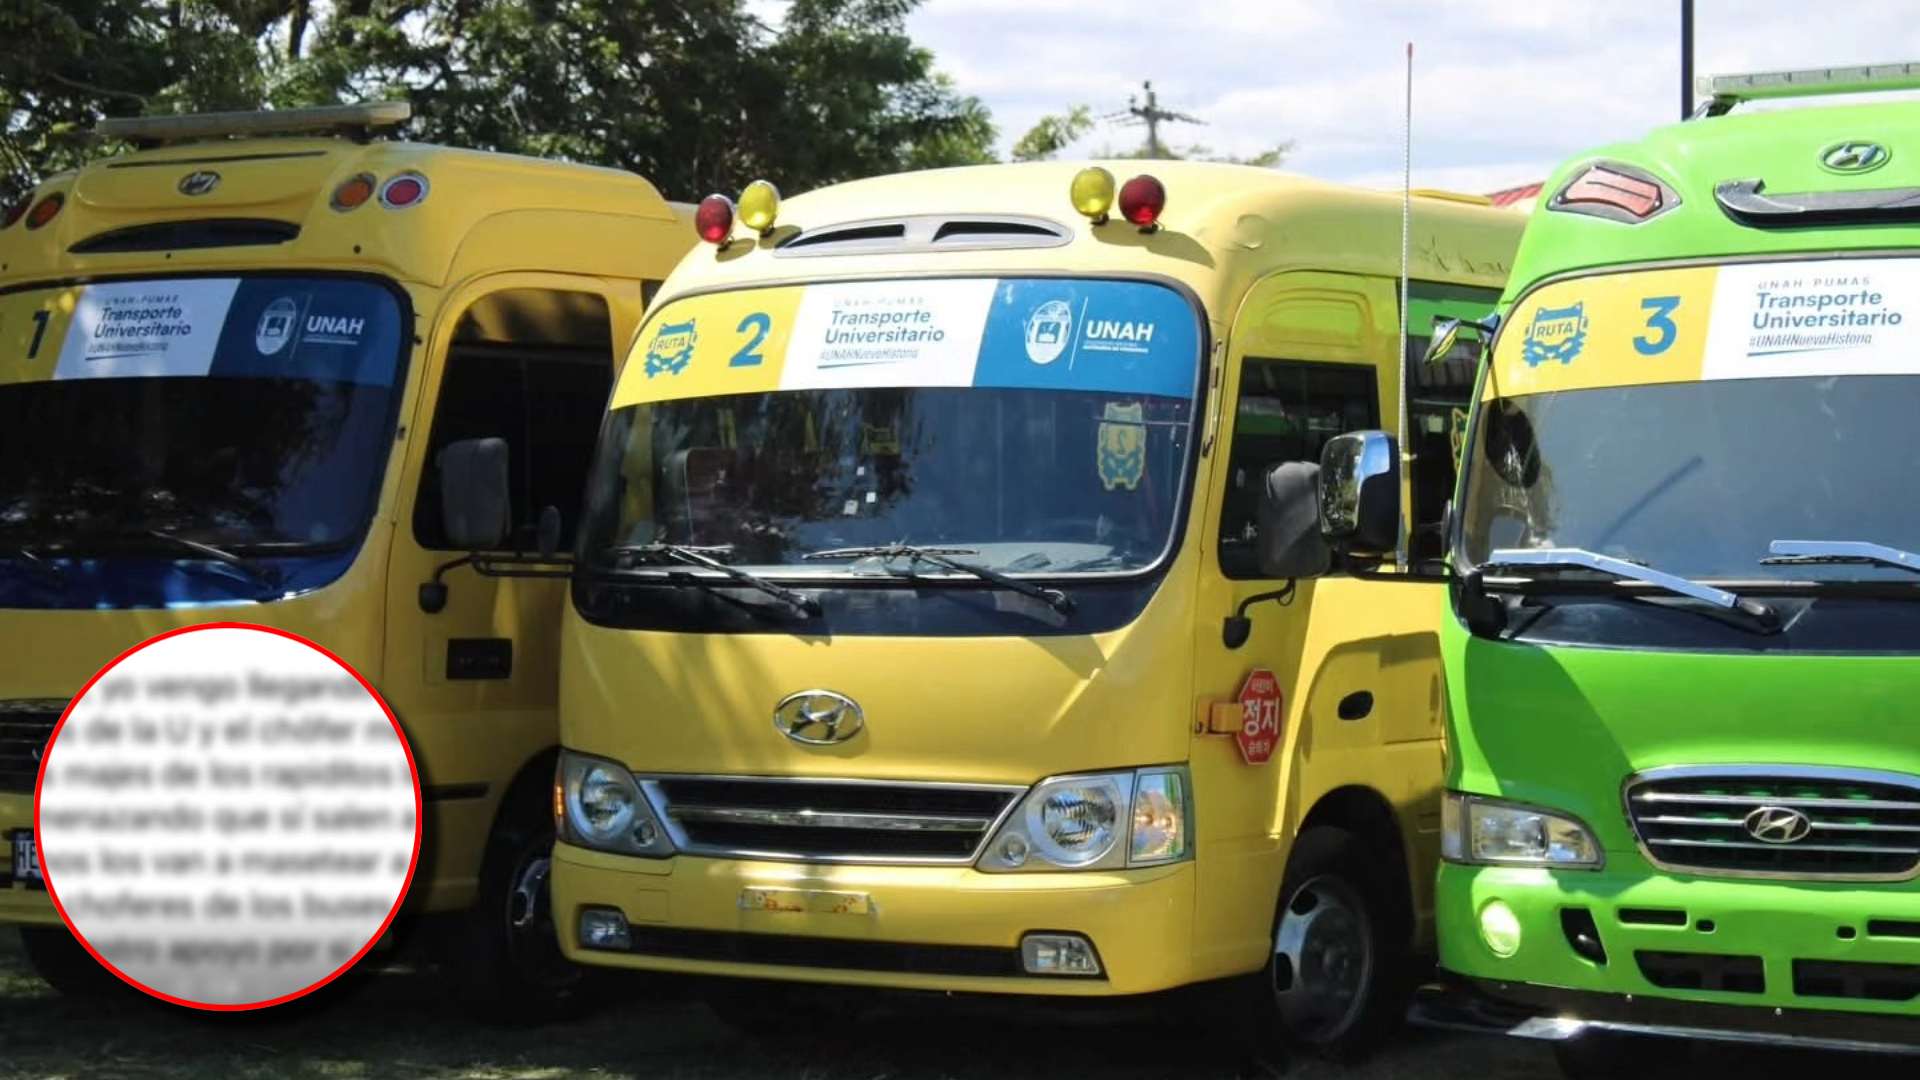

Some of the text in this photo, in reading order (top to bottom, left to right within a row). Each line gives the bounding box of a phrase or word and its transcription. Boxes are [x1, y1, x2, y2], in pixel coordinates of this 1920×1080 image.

[1756, 290, 1883, 312] Transporte
[101, 306, 183, 324] Transporte
[306, 315, 366, 337] UNAH
[831, 309, 931, 328] Transporte
[1632, 295, 1681, 356] 3
[1753, 308, 1903, 330] Universitario
[25, 309, 52, 360] 1
[94, 322, 191, 339] Universitario
[728, 311, 771, 368] 2
[824, 325, 945, 344] Universitario
[1085, 319, 1155, 342] UNAH
[1536, 322, 1574, 338] RUTA
[655, 336, 685, 351] RUTA
[1243, 697, 1280, 736] 정지
